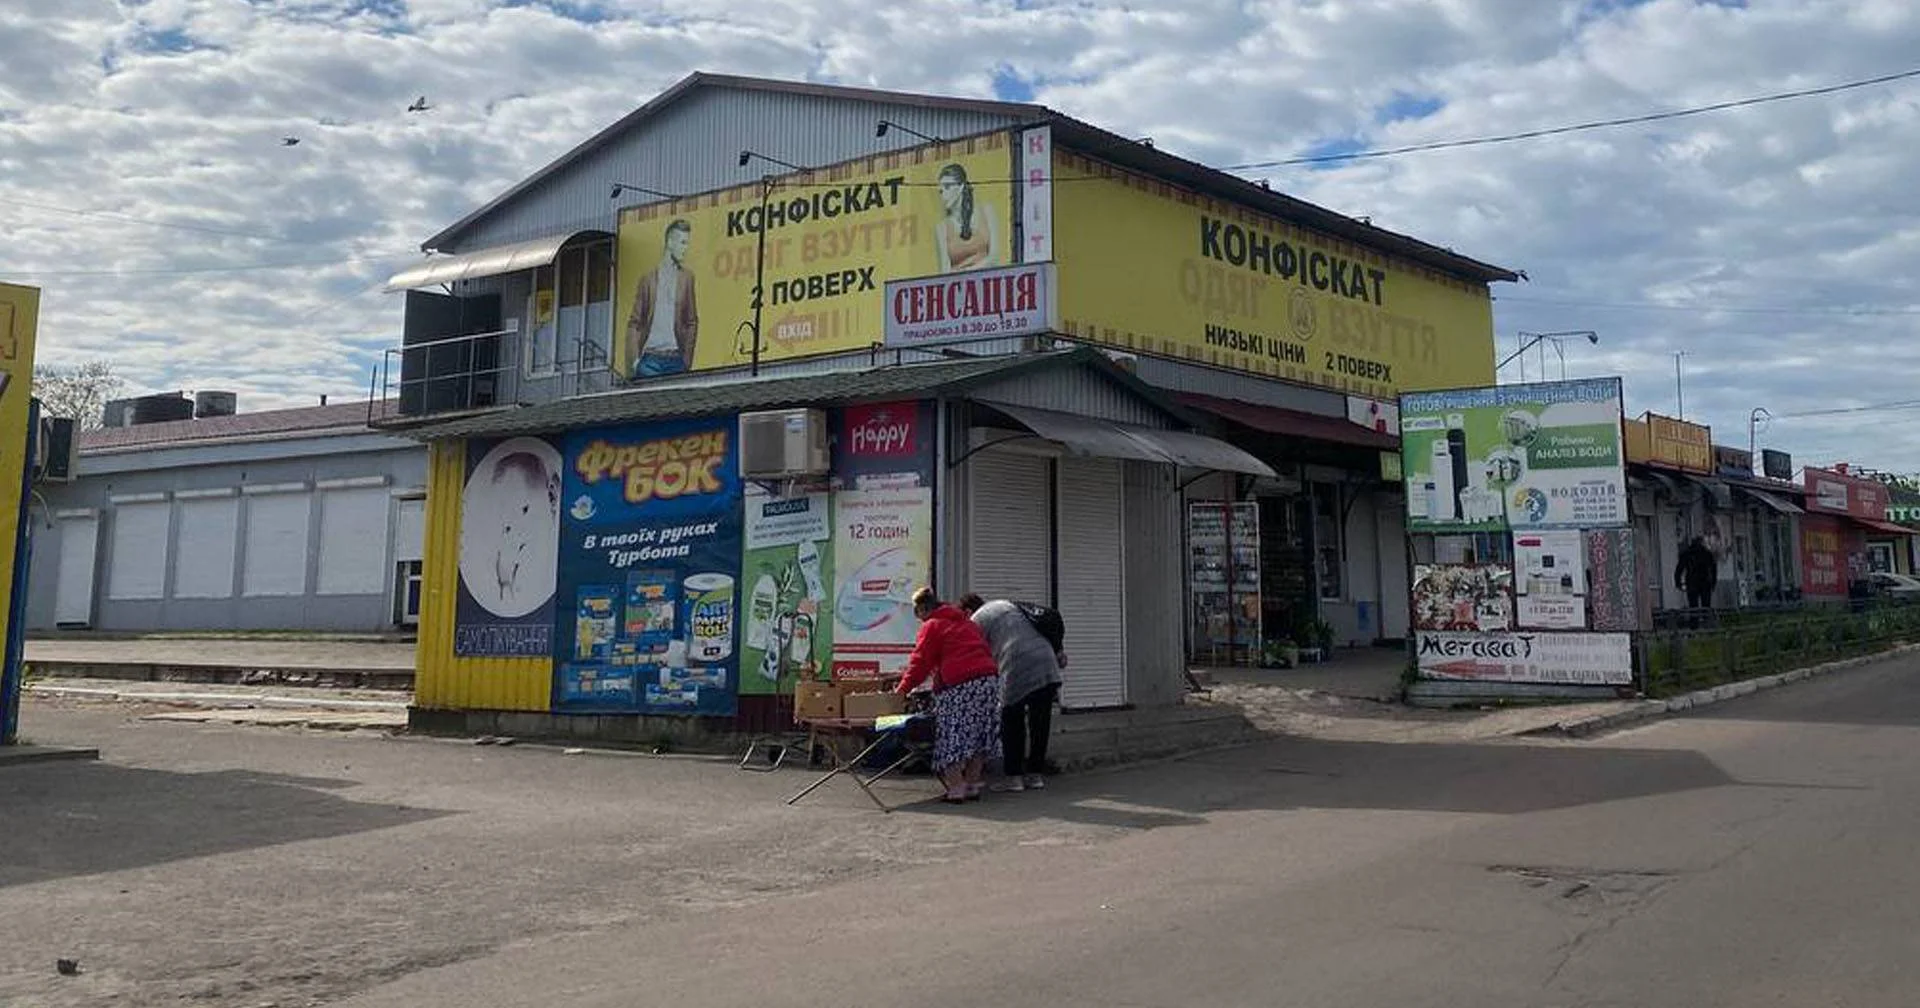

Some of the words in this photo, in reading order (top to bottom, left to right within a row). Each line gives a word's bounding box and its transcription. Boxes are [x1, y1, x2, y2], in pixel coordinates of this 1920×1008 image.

[727, 176, 904, 237] КОНФІСКАТ
[803, 214, 919, 263] ВЗУТТЯ
[1200, 215, 1386, 306] КОНФІСКАТ
[751, 286, 763, 309] 2
[772, 266, 875, 305] ПОВЕРХ
[894, 272, 1037, 325] СЕНСАЦІЯ
[777, 322, 812, 339] ВХІД
[1180, 258, 1266, 326] ОДЯГ
[1329, 304, 1438, 364] ВЗУТТЯ
[1205, 324, 1263, 354] НИЗЬКІ
[1268, 337, 1306, 365] ЦІНИ
[1325, 352, 1334, 371] 2
[1338, 354, 1392, 383] ПОВЕРХ
[577, 430, 726, 484] Фрекен
[852, 420, 909, 454] Happy
[1536, 449, 1576, 459] АНАЛІЗ
[1578, 446, 1612, 457] ВОДИ
[584, 535, 595, 549] В
[601, 528, 656, 547] твоїх
[659, 522, 718, 544] руках
[849, 524, 865, 539] 12
[608, 544, 690, 568] Турбота
